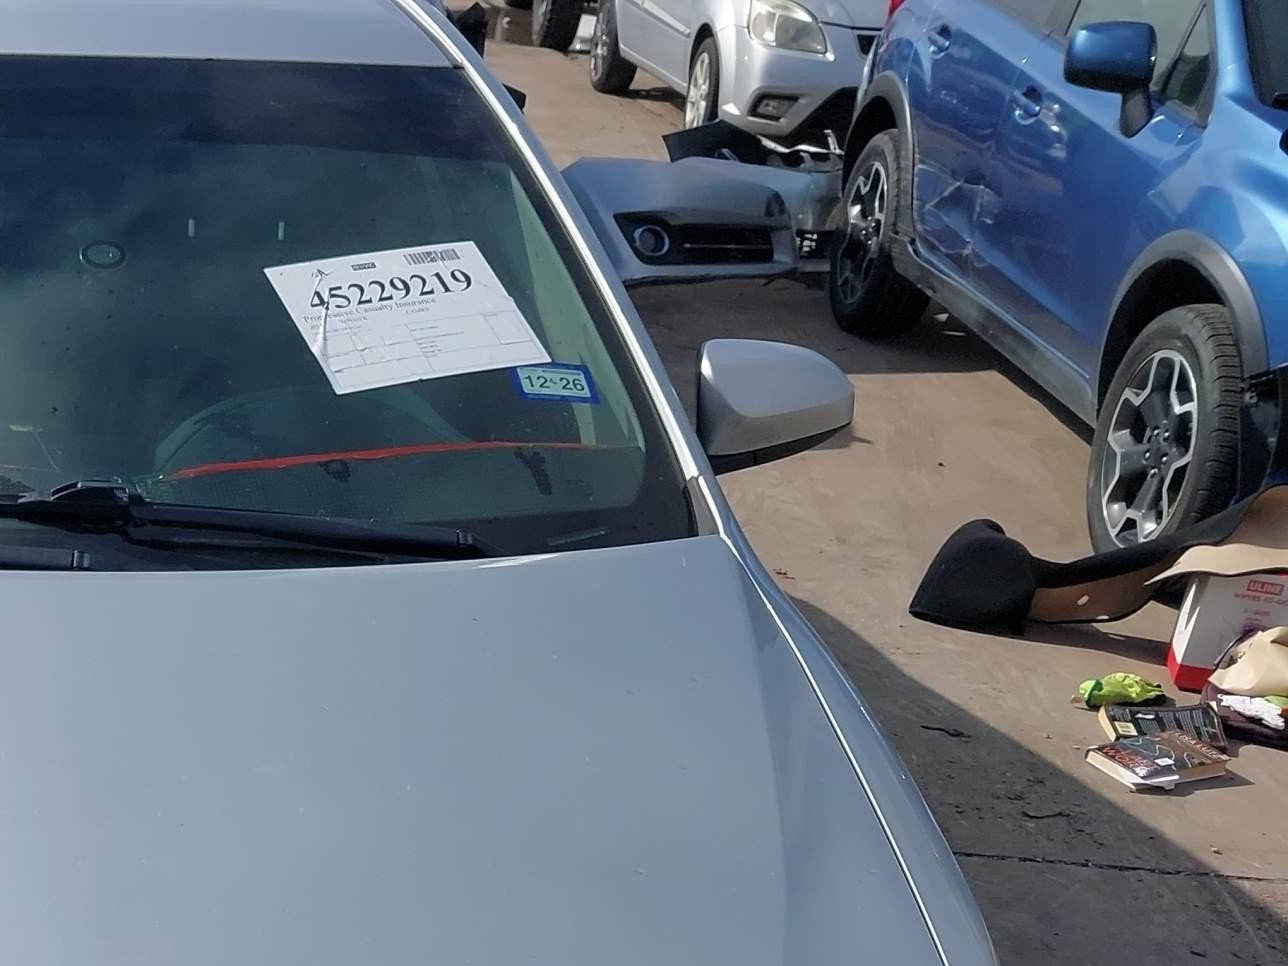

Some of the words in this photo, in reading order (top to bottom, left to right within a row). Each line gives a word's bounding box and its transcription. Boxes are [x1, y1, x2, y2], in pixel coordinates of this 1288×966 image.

[310, 268, 472, 309] 45229219
[304, 309, 354, 323] Progessive
[395, 298, 437, 309] Insurance
[524, 375, 551, 389] 12
[559, 377, 585, 391] 26
[1249, 581, 1283, 596] ULINE
